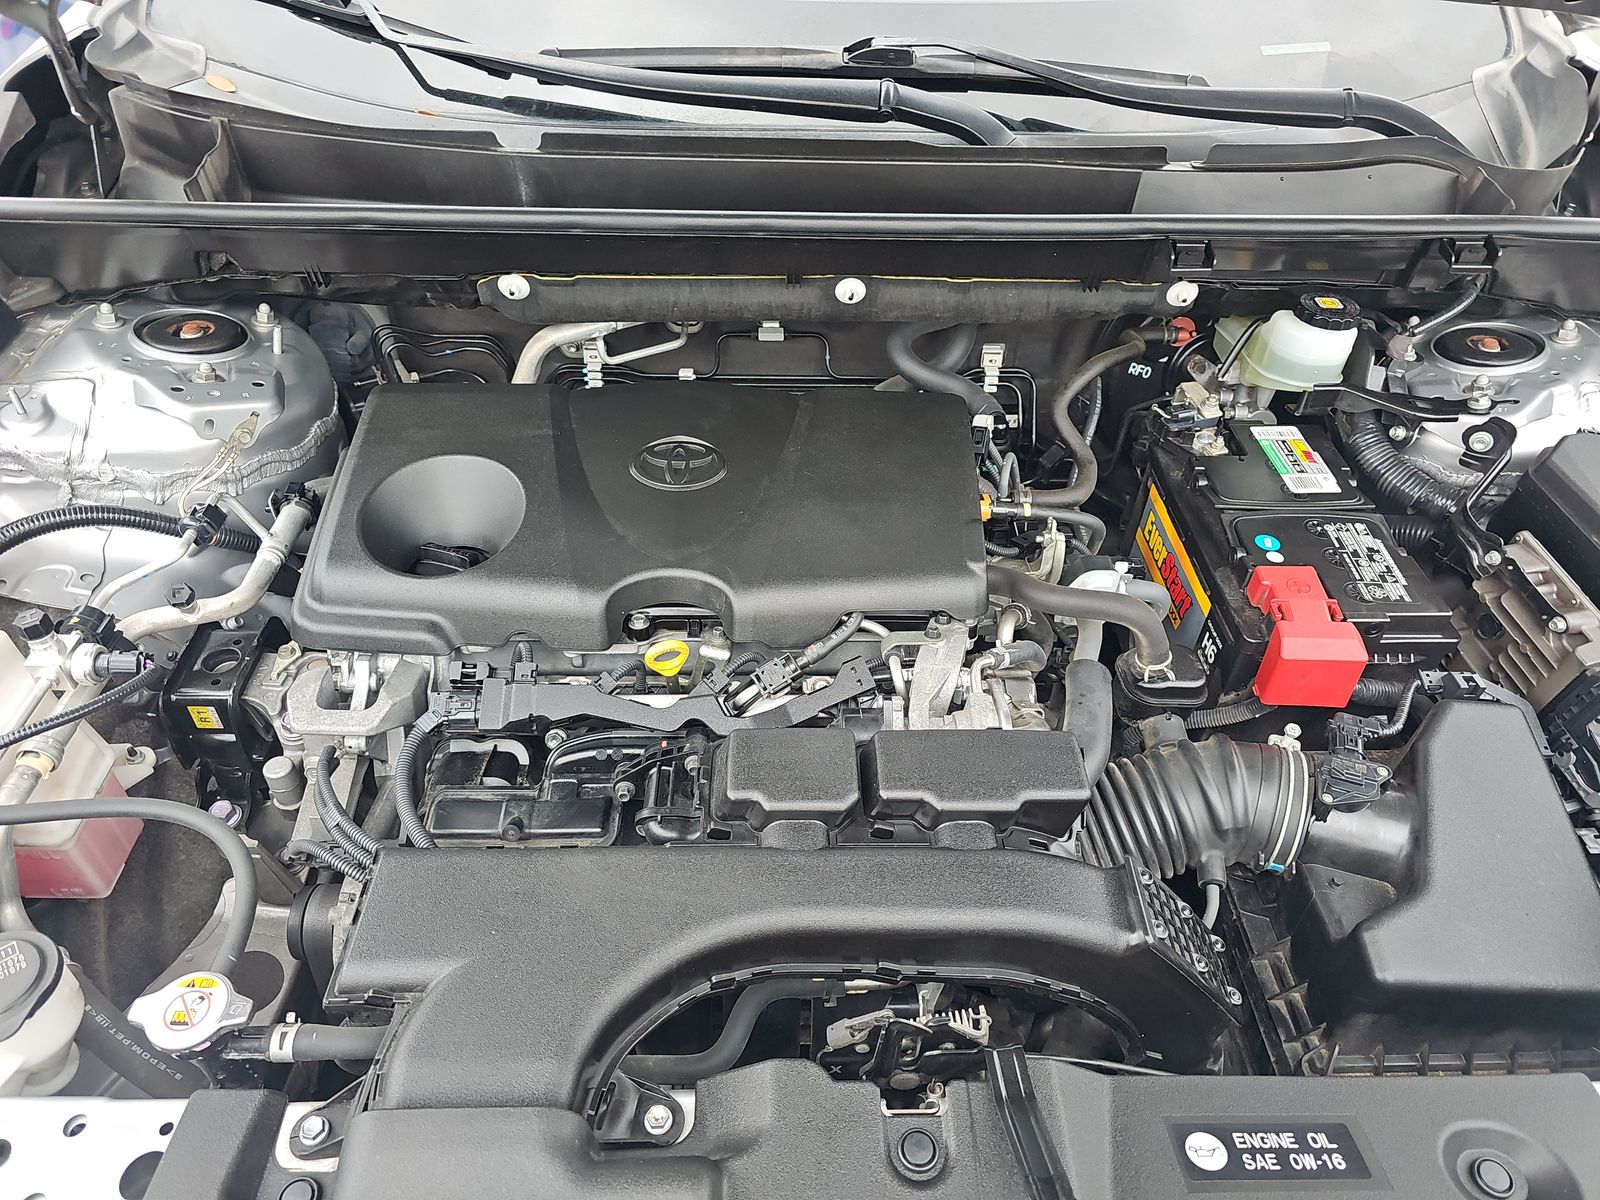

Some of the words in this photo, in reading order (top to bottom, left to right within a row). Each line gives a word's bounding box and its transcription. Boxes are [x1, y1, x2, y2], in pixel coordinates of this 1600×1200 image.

[1143, 511, 1193, 619] EverStart
[1201, 631, 1218, 664] H6
[1231, 1132, 1299, 1149] ENGINE
[1306, 1132, 1338, 1149] OIL
[1241, 1153, 1282, 1170] SAE
[1289, 1153, 1347, 1170] 0W-16
